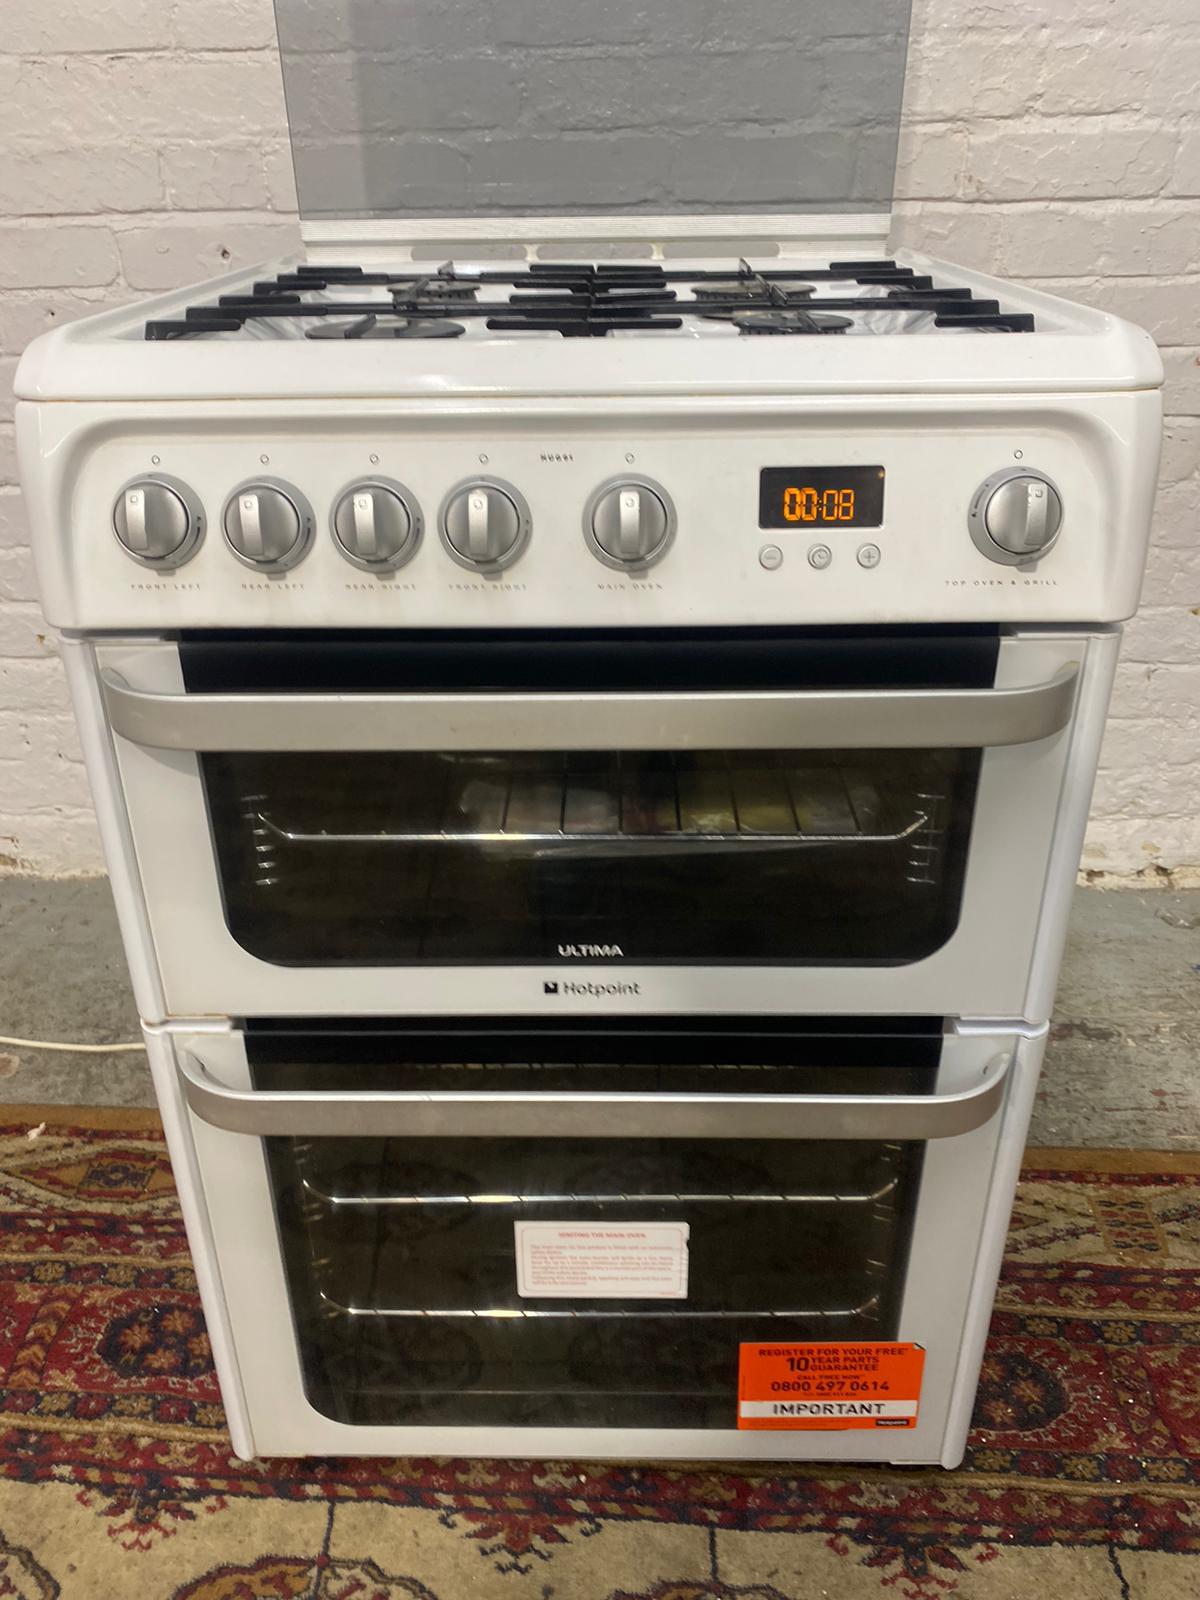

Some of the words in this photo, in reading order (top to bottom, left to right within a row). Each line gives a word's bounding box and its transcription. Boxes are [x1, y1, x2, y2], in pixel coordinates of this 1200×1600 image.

[783, 487, 855, 521] 00:08
[381, 583, 416, 591] RIGHT
[492, 583, 527, 591] RIGHT
[558, 944, 624, 957] ULTIMA
[563, 981, 641, 999] Hotpoint
[787, 1356, 810, 1371] 10
[771, 1381, 811, 1391] 0800
[816, 1381, 846, 1391] 497
[850, 1381, 889, 1391] 0614
[773, 1403, 886, 1415] IMPORTANT
